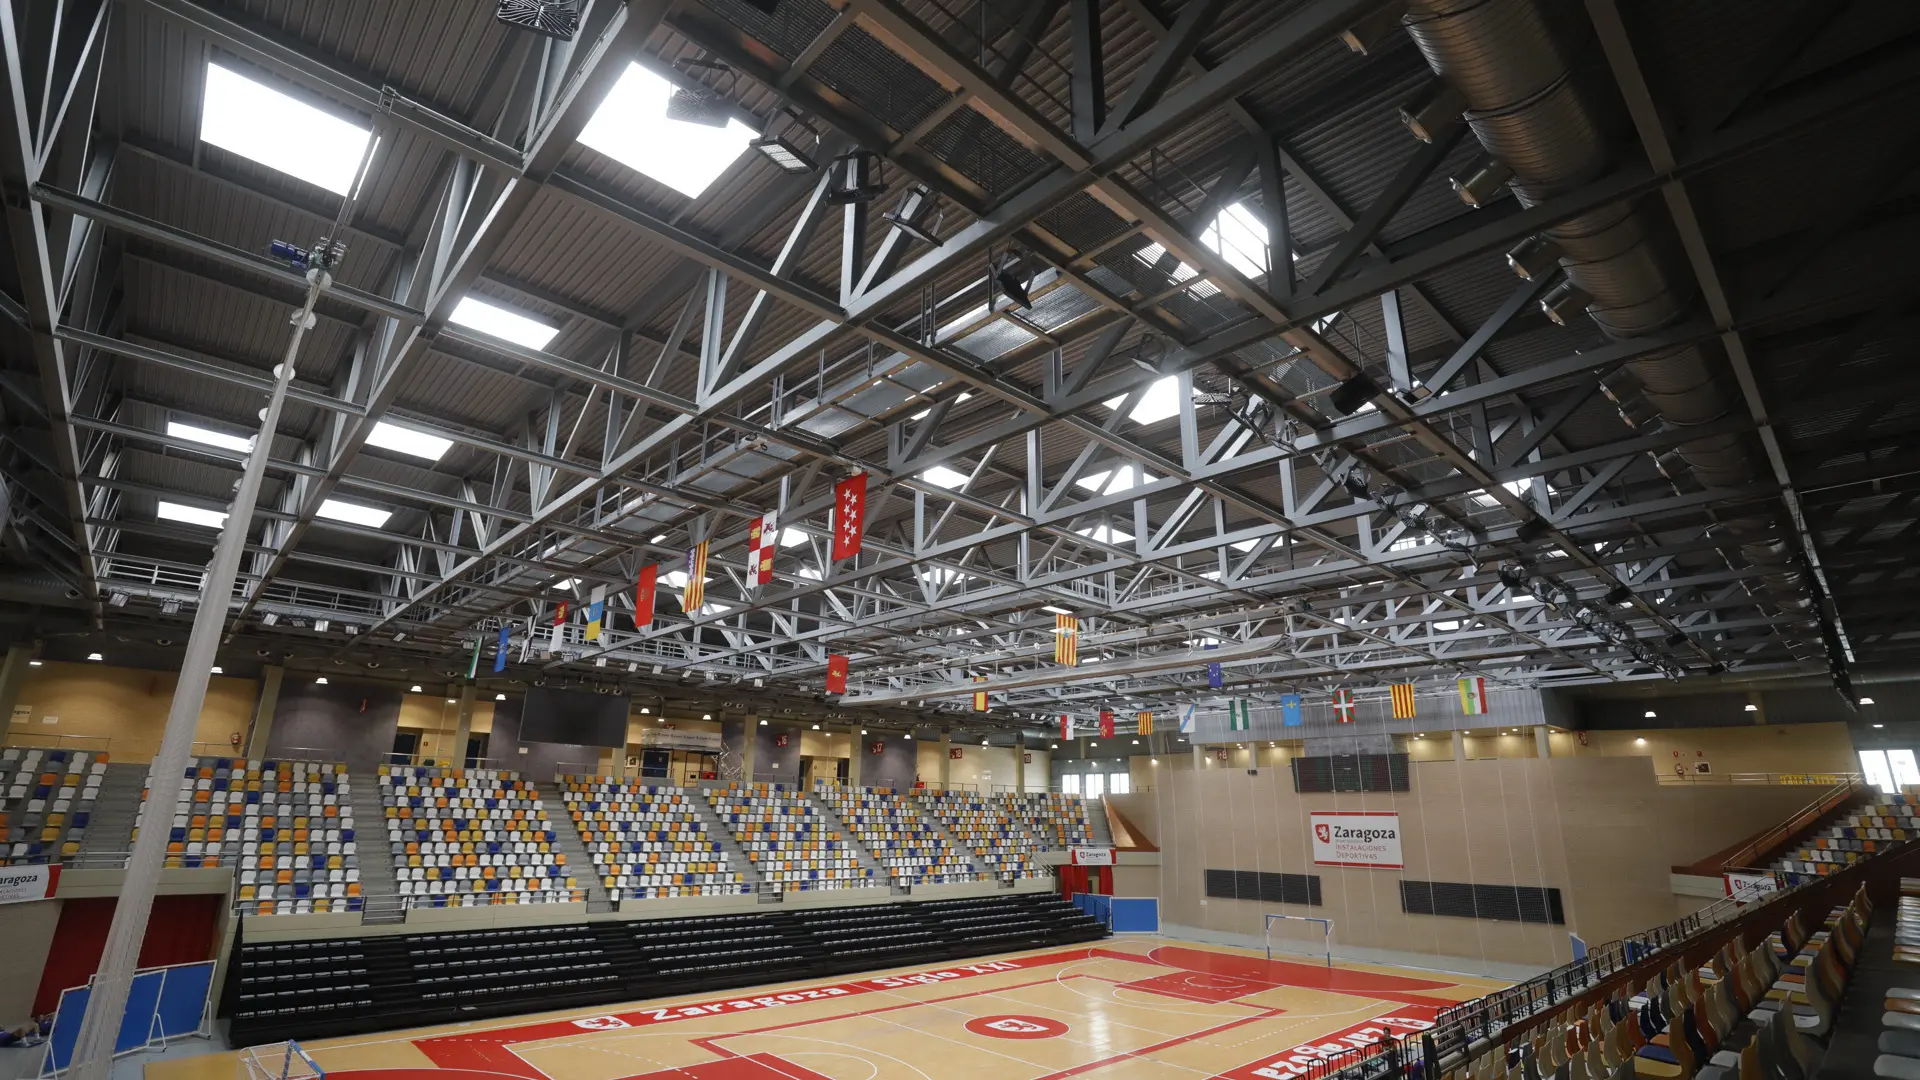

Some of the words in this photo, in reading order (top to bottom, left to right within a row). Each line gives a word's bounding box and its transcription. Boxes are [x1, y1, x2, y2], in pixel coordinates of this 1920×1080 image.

[877, 743, 883, 753] 17
[955, 750, 962, 758] 18
[1333, 826, 1396, 843] Zaragoza
[1335, 844, 1387, 852] INSTALACIONES
[1336, 851, 1378, 860] DEPORTIVAS
[640, 986, 849, 1021] Zaragoza
[871, 971, 961, 988] Siglo
[960, 960, 1022, 974] XXI
